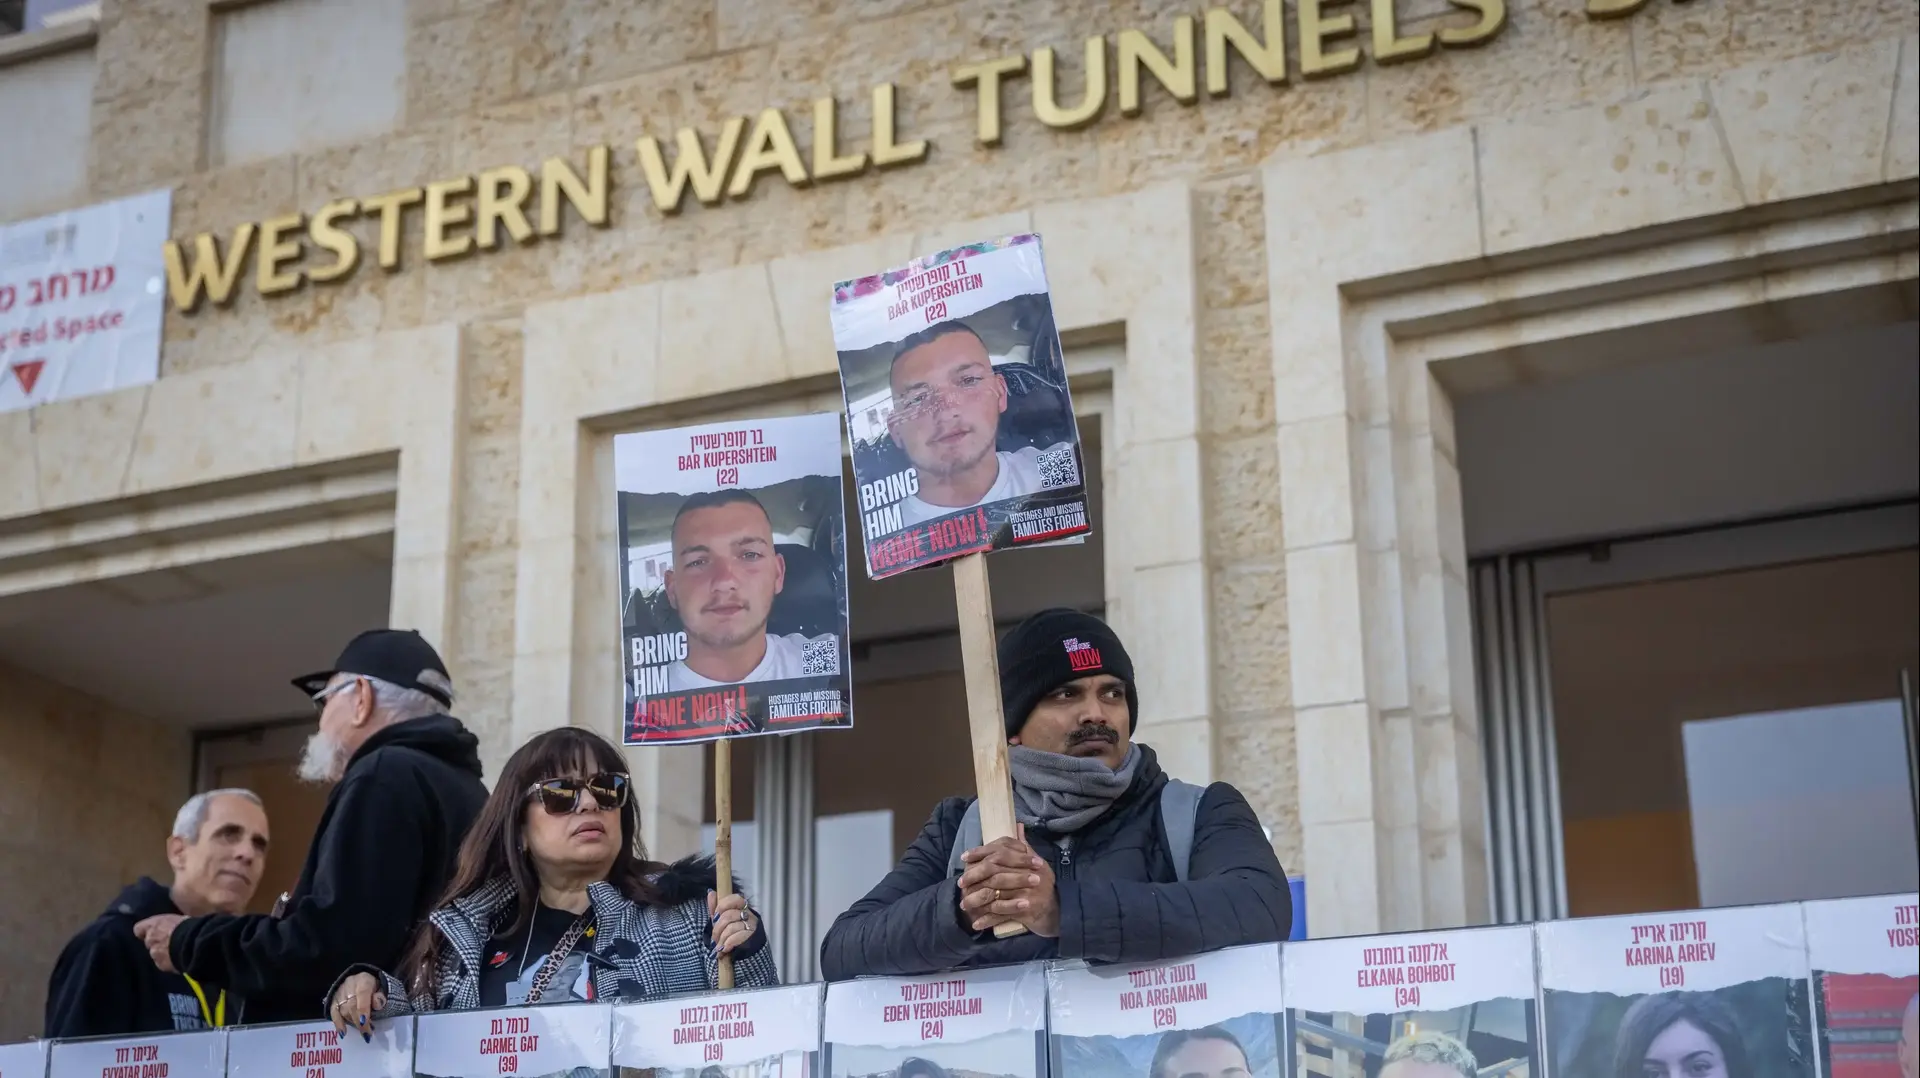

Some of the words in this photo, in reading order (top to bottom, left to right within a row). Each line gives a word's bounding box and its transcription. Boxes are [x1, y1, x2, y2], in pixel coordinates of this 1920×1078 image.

[163, 144, 610, 312] WESTERN
[636, 82, 929, 214] WALL
[951, 0, 1506, 145] TUNNELS
[952, 260, 967, 276] בר
[888, 299, 909, 321] BAR
[911, 273, 983, 311] KUPERSHTEIN
[925, 301, 947, 323] (22)
[53, 310, 124, 343] Space
[690, 430, 747, 453] קופרשטיין
[750, 429, 763, 444] בר
[678, 454, 700, 471] BAR
[704, 446, 777, 468] KUPERSHTEIN
[716, 467, 739, 487] (22)
[860, 467, 919, 512] BRING
[865, 503, 904, 540] HIM
[1010, 509, 1042, 524] HOSTAGES
[1043, 506, 1056, 518] AND
[1057, 501, 1083, 516] MISSING
[1012, 517, 1053, 538] FAMILIES
[1054, 512, 1086, 530] FORUM
[871, 528, 927, 571] HOME
[631, 631, 688, 665] BRING
[1069, 648, 1100, 667] NOW
[633, 665, 669, 697] HIM
[768, 693, 799, 705] HOSTAGES
[800, 692, 812, 702] AND
[813, 690, 841, 701] MISSING
[633, 696, 687, 728] HOME
[769, 703, 808, 719] FAMILIES
[810, 700, 841, 715] FORUM
[1631, 924, 1665, 944] ארייב
[1669, 921, 1707, 942] קרינה
[1363, 946, 1405, 966] בוחבוט
[1408, 942, 1449, 964] אלקנה
[1625, 946, 1674, 967] KARINA
[1678, 942, 1716, 962] ARIEV
[1169, 963, 1196, 983] נועה
[1358, 966, 1404, 987] ELKANA
[1408, 963, 1456, 984] BOHBOT
[1660, 965, 1684, 988] (19)
[901, 982, 944, 1001] ירושלמי
[947, 980, 966, 1000] עדן
[1120, 991, 1144, 1010] NOA
[1147, 982, 1208, 1007] ARGAMANI
[1395, 986, 1420, 1008] (34)
[680, 1006, 709, 1025] גלבוע
[712, 1002, 748, 1022] דניאלה
[884, 1004, 910, 1022] EDEN
[913, 998, 982, 1020] YERUSHALMI
[1153, 1006, 1177, 1028] (26)
[490, 1019, 503, 1035] גת
[506, 1017, 529, 1033] כרמל
[673, 1025, 715, 1045] DANIELA
[718, 1021, 755, 1040] GILBOA
[921, 1020, 944, 1040] (24)
[296, 1032, 316, 1049] דנינו
[319, 1030, 338, 1047] אורי
[480, 1036, 517, 1054] CARMEL
[521, 1035, 539, 1052] GAT
[115, 1048, 129, 1063] דוד
[291, 1051, 306, 1067] ORI
[308, 1048, 342, 1066] DANINO
[704, 1042, 723, 1062] (19)
[102, 1065, 140, 1078] EVYATAR
[142, 1063, 168, 1078] DAVID
[498, 1055, 518, 1074] (39)
